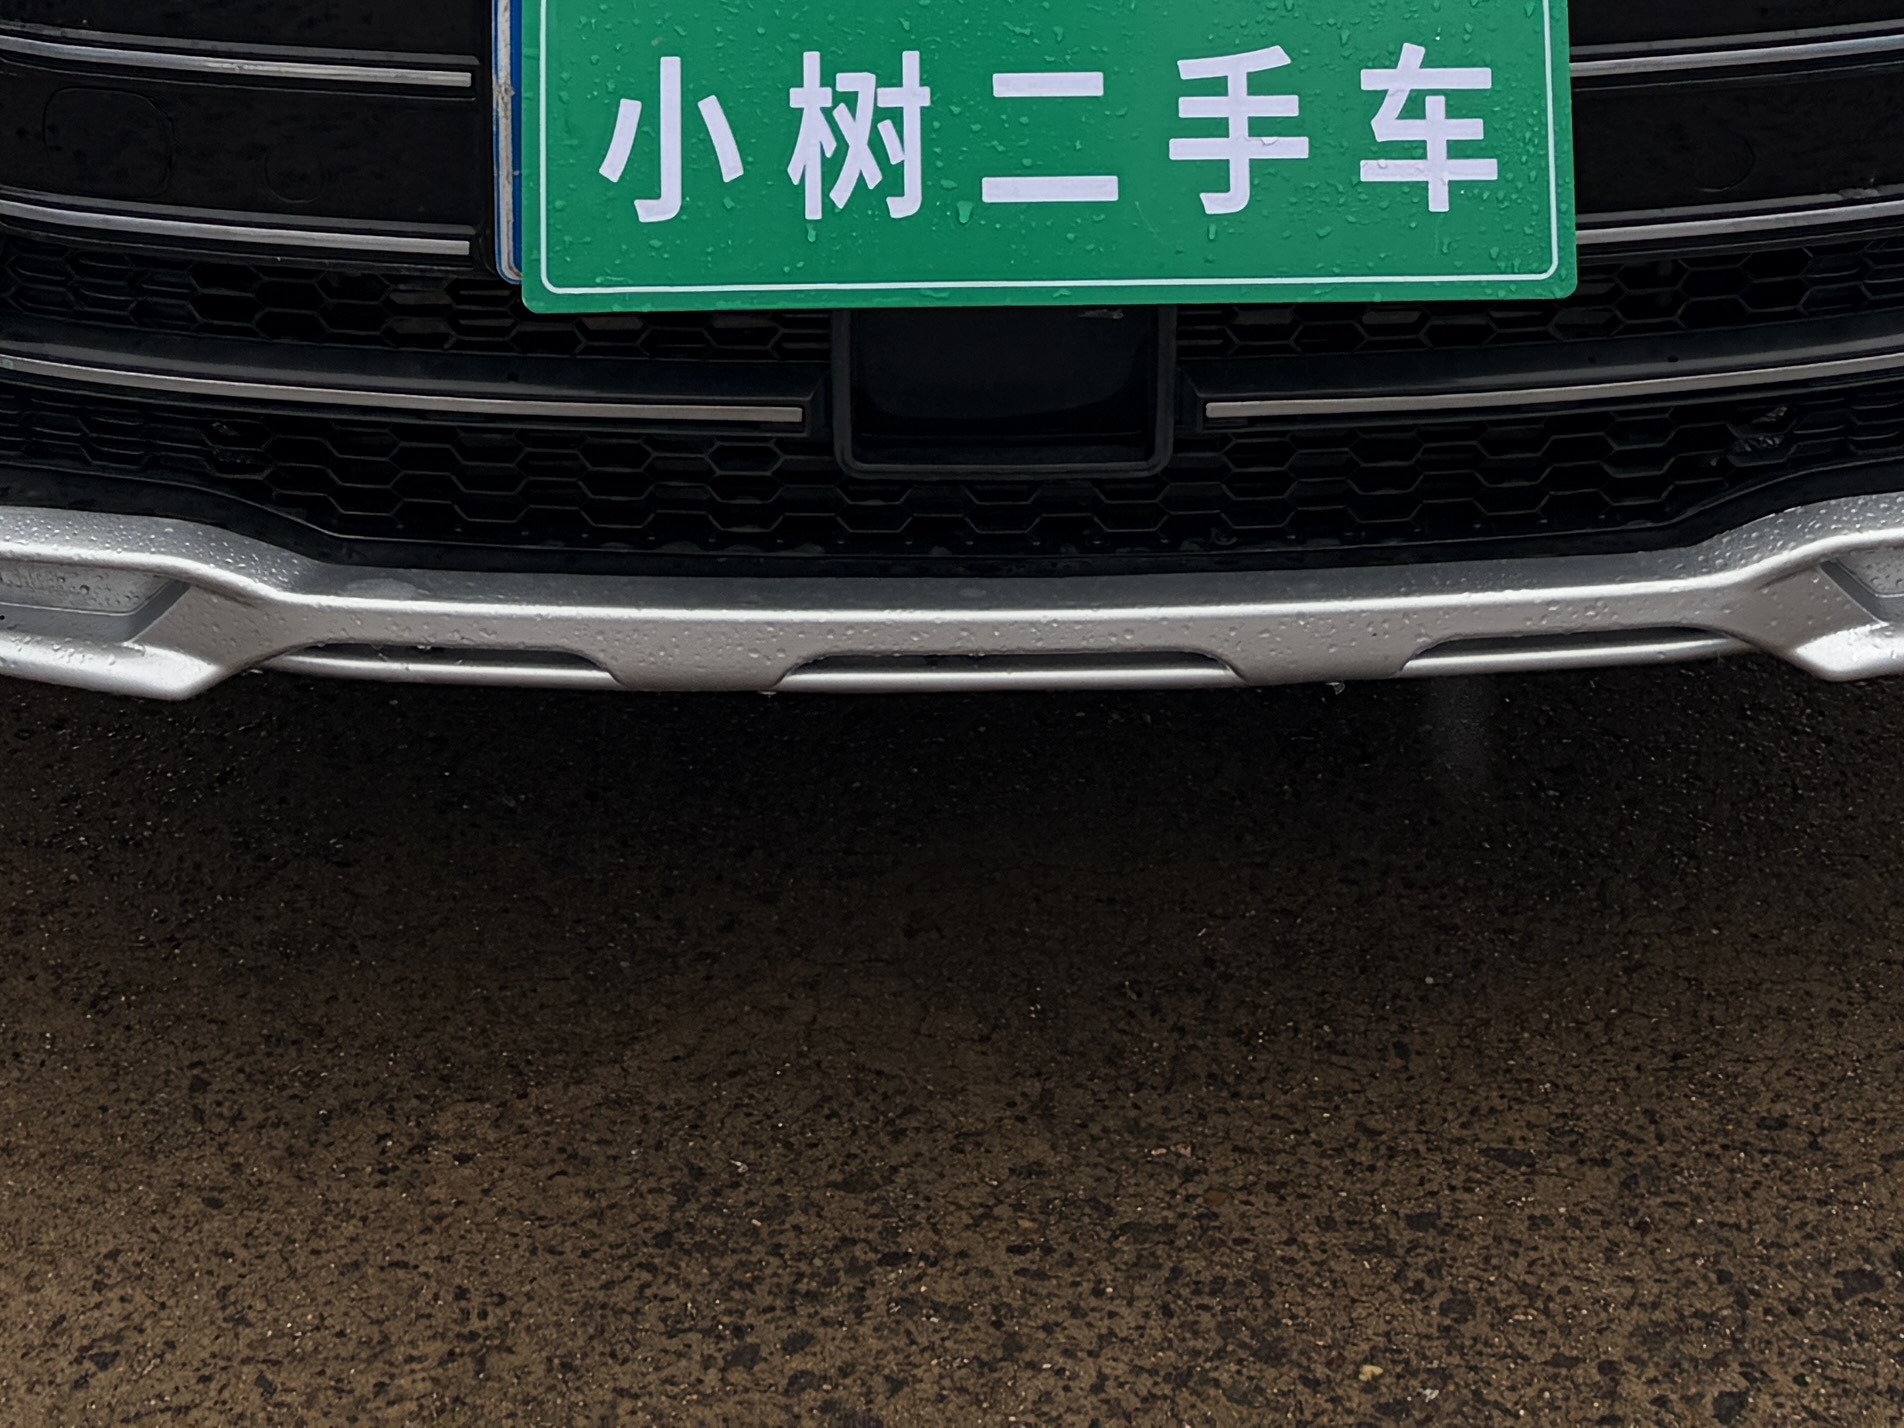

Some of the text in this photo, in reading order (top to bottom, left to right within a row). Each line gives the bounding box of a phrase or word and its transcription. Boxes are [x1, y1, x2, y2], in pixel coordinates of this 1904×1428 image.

[596, 42, 1499, 224] 小树二手车
